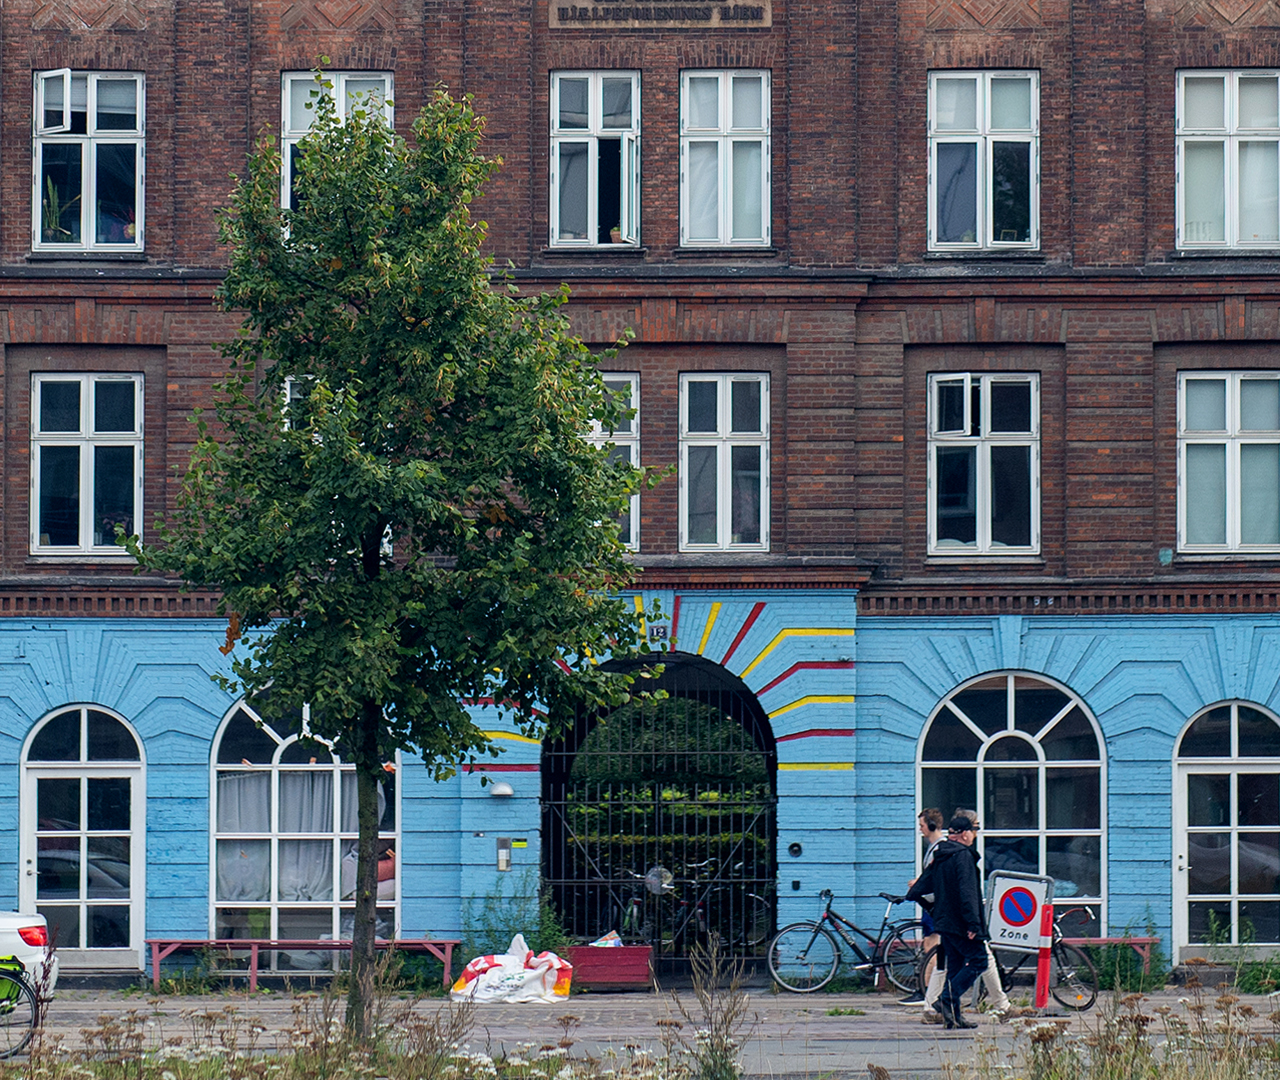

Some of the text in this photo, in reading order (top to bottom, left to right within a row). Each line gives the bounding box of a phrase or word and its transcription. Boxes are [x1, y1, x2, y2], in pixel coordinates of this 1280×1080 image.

[720, 5, 763, 21] HJEM
[652, 627, 664, 636] 12
[1000, 928, 1029, 940] Zone
